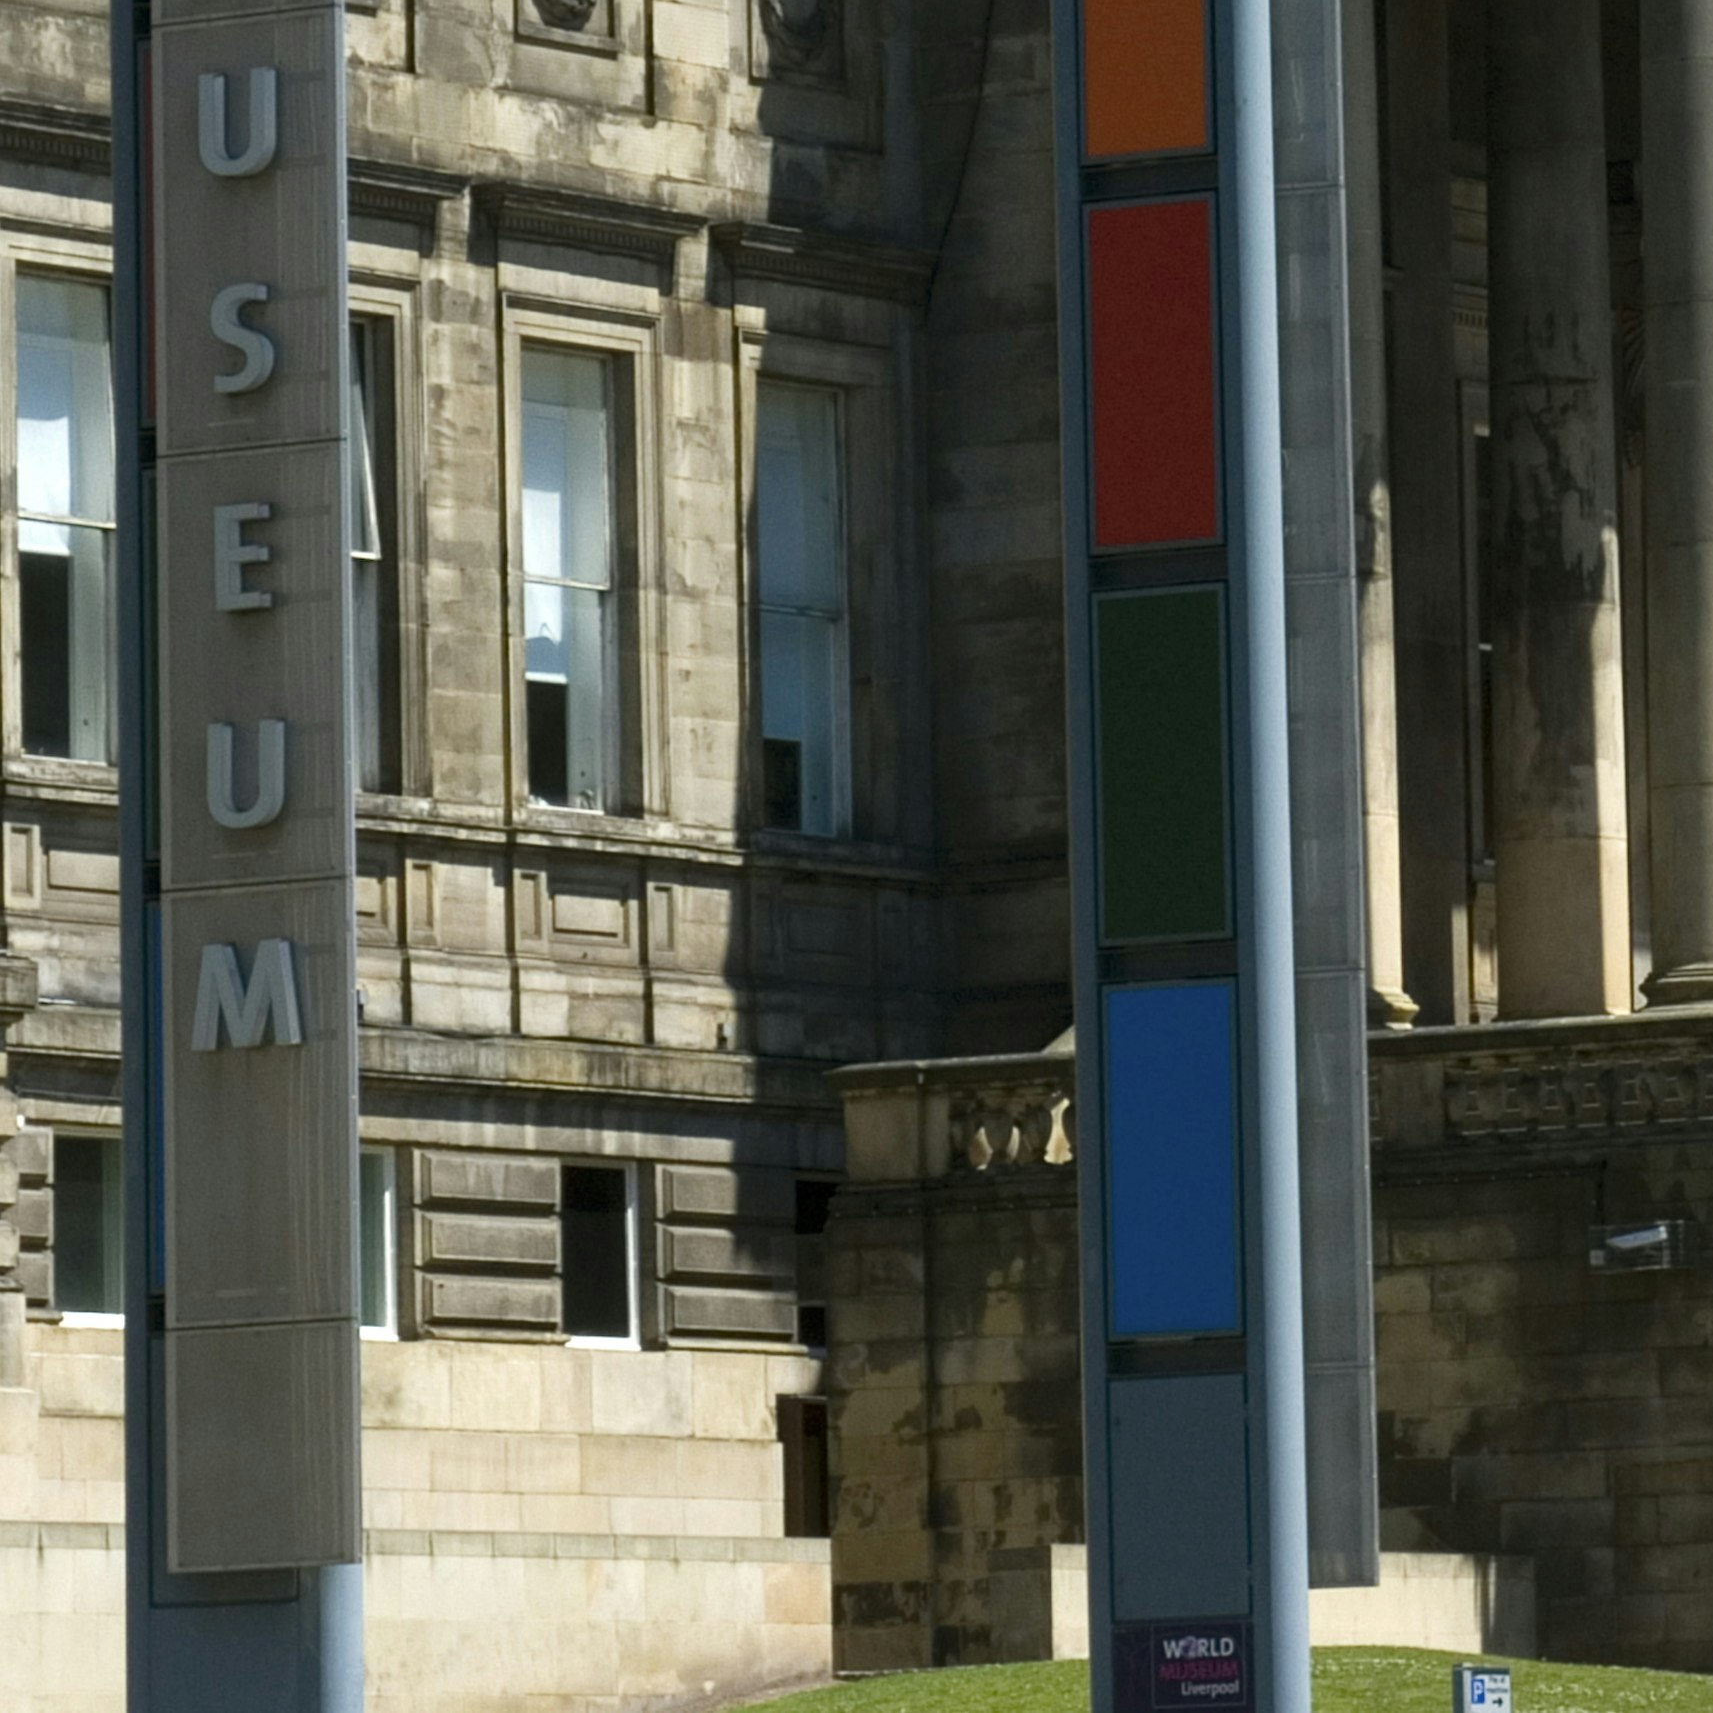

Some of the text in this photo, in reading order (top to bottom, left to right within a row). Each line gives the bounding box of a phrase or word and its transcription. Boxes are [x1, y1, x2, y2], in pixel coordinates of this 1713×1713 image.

[1163, 1636, 1234, 1659] WORLD
[1160, 1660, 1238, 1680] MUSEUM
[1181, 1680, 1239, 1698] Liverpool
[1473, 1681, 1483, 1702] P
